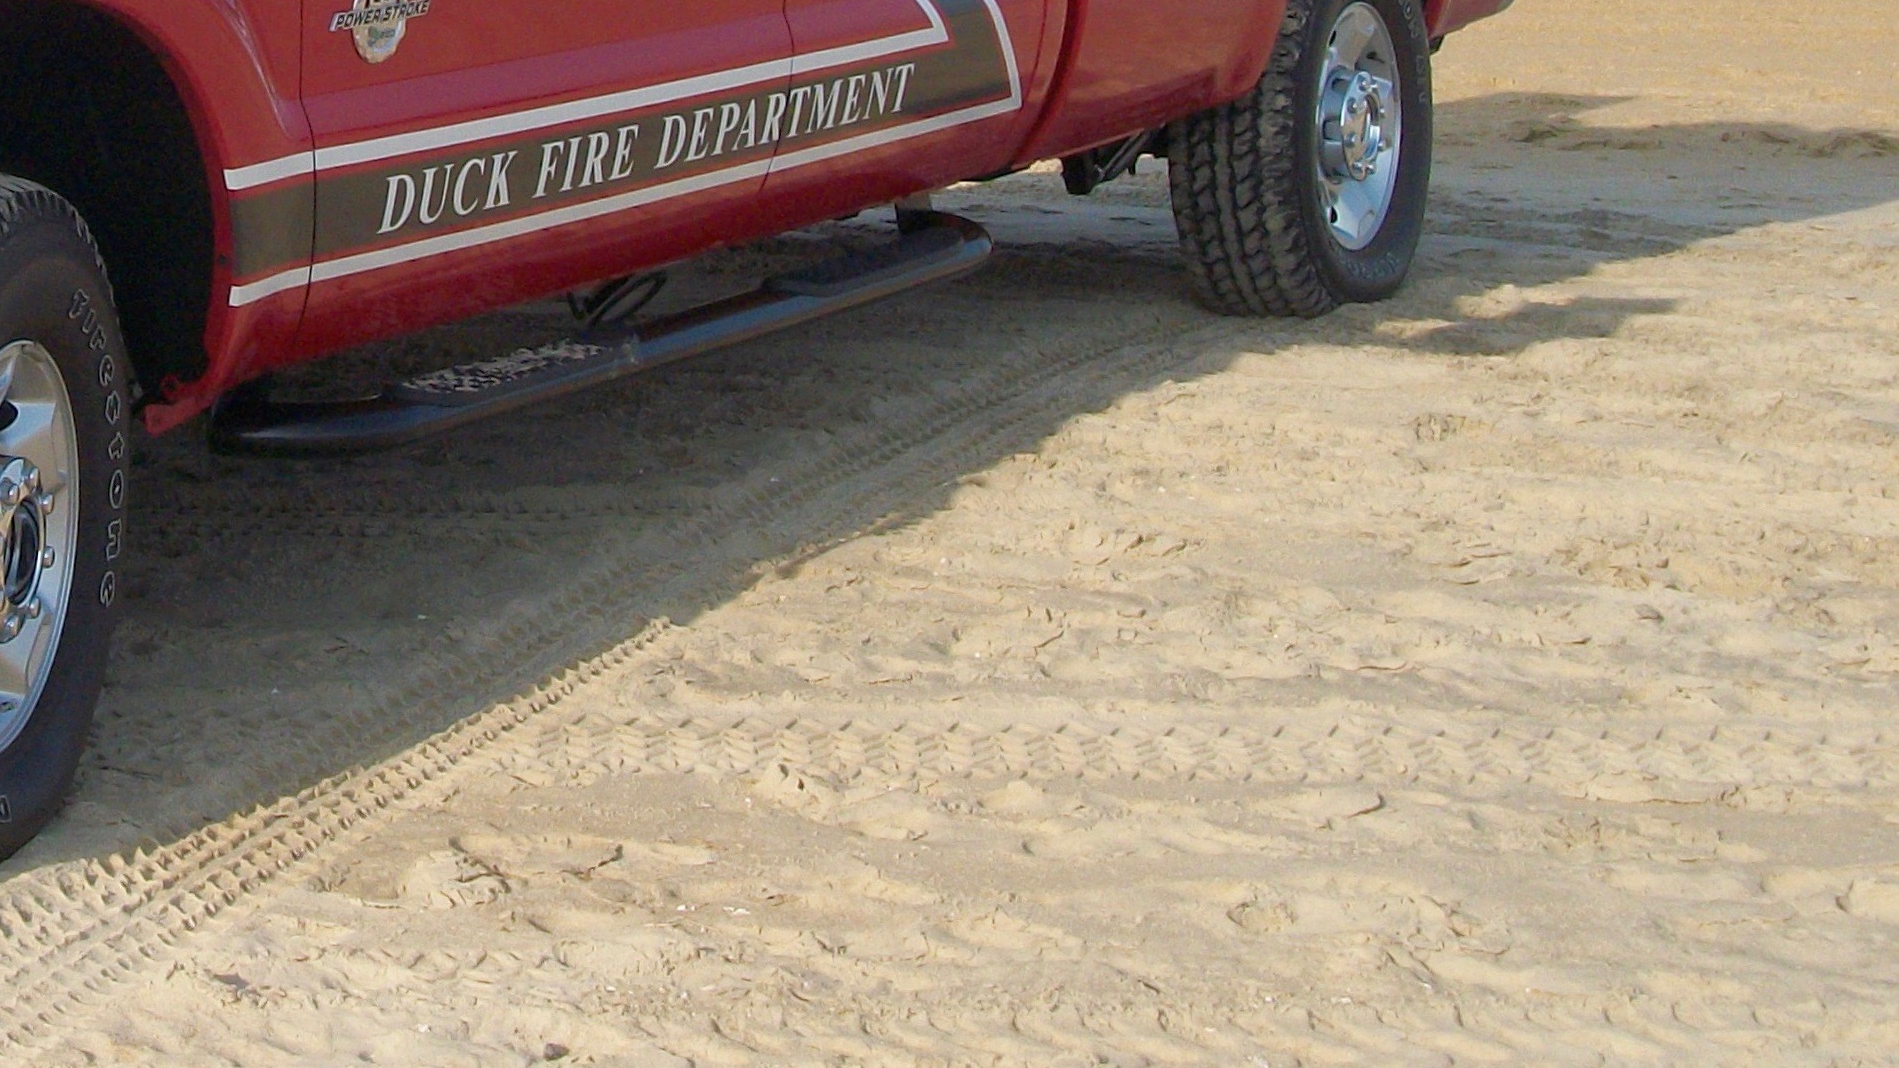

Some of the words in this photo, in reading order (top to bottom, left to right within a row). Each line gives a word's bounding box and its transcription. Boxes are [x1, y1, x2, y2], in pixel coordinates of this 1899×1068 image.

[335, 9, 382, 28] POWER
[375, 149, 519, 235] DUCK
[530, 123, 640, 199] FIRE
[652, 61, 916, 171] DEPARTMENT
